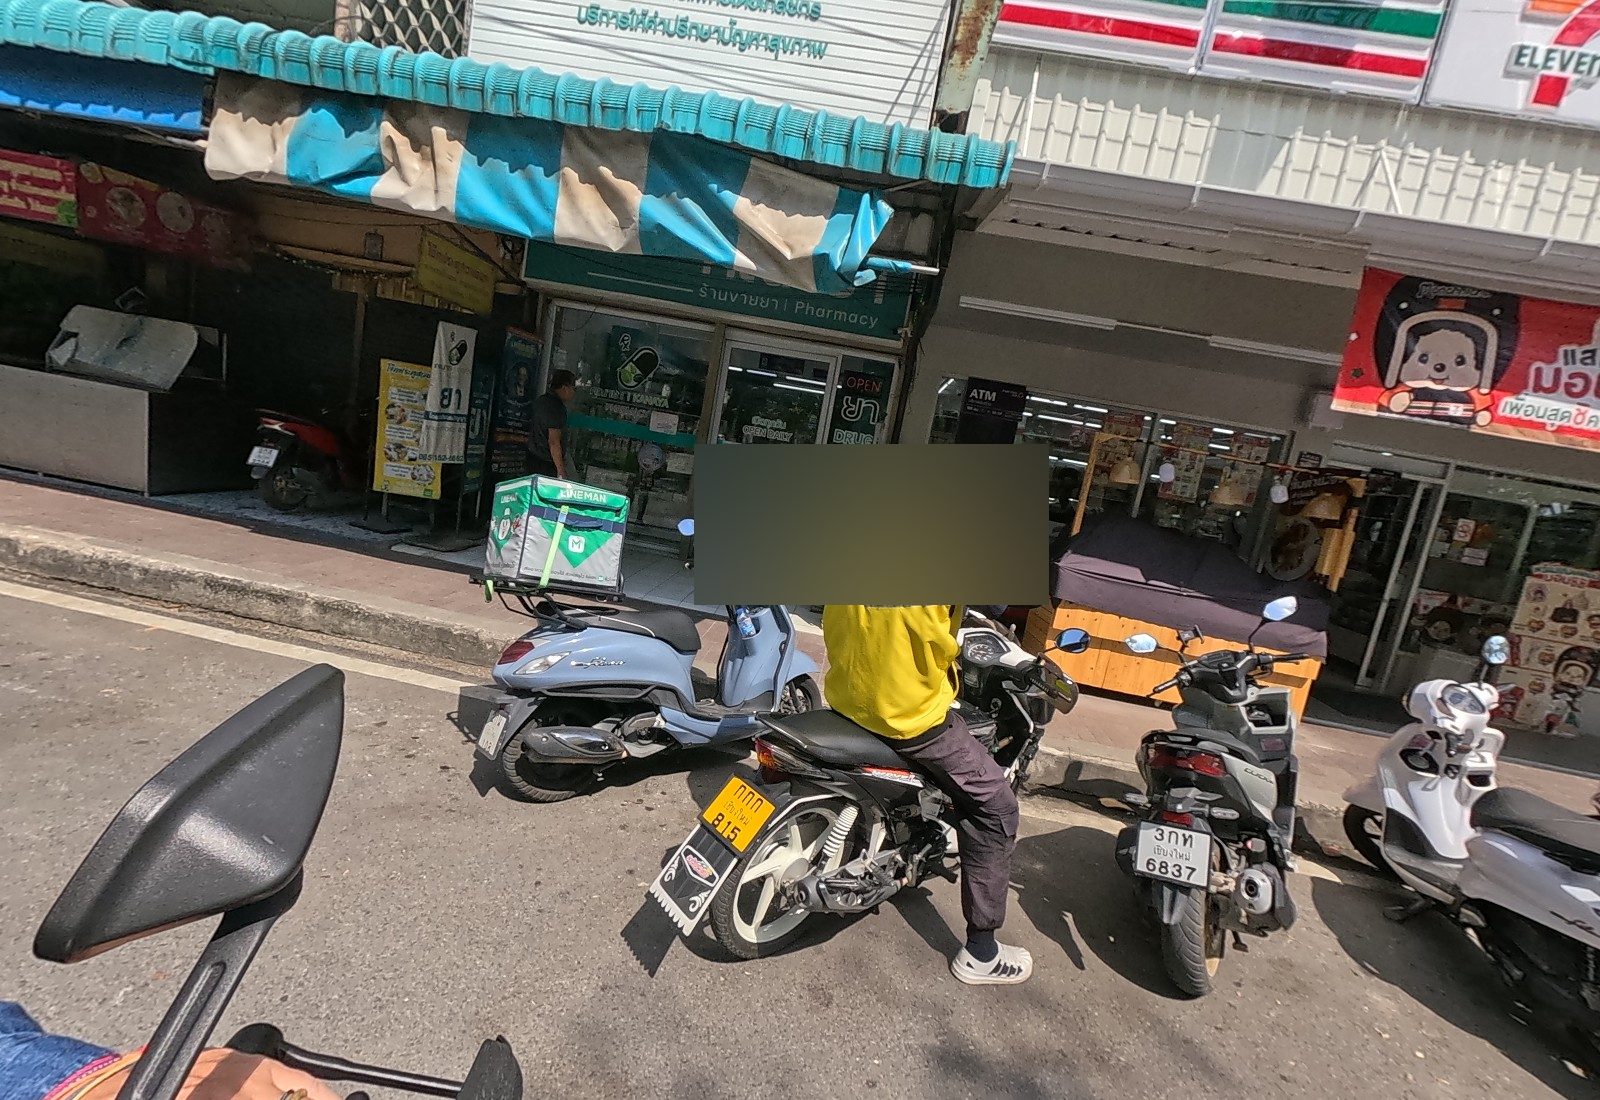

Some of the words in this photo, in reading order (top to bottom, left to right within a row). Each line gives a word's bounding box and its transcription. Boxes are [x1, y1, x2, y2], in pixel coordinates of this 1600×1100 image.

[577, 3, 829, 60] บริการให้คำปรึกษาปัญหาสุขภาพ
[699, 284, 780, 311] ร้านขายยา
[795, 301, 880, 329] Pharmacy
[846, 376, 882, 393] OPEN
[969, 388, 997, 402] ATM
[1532, 366, 1600, 400] มอ
[841, 395, 881, 426] ยา
[742, 424, 767, 438] OPEN
[766, 428, 793, 442] DAILY
[711, 812, 742, 843] 815
[1154, 827, 1194, 849] 3กท
[1153, 845, 1192, 862] เชียงใหม่
[1146, 857, 1198, 882] 6837
